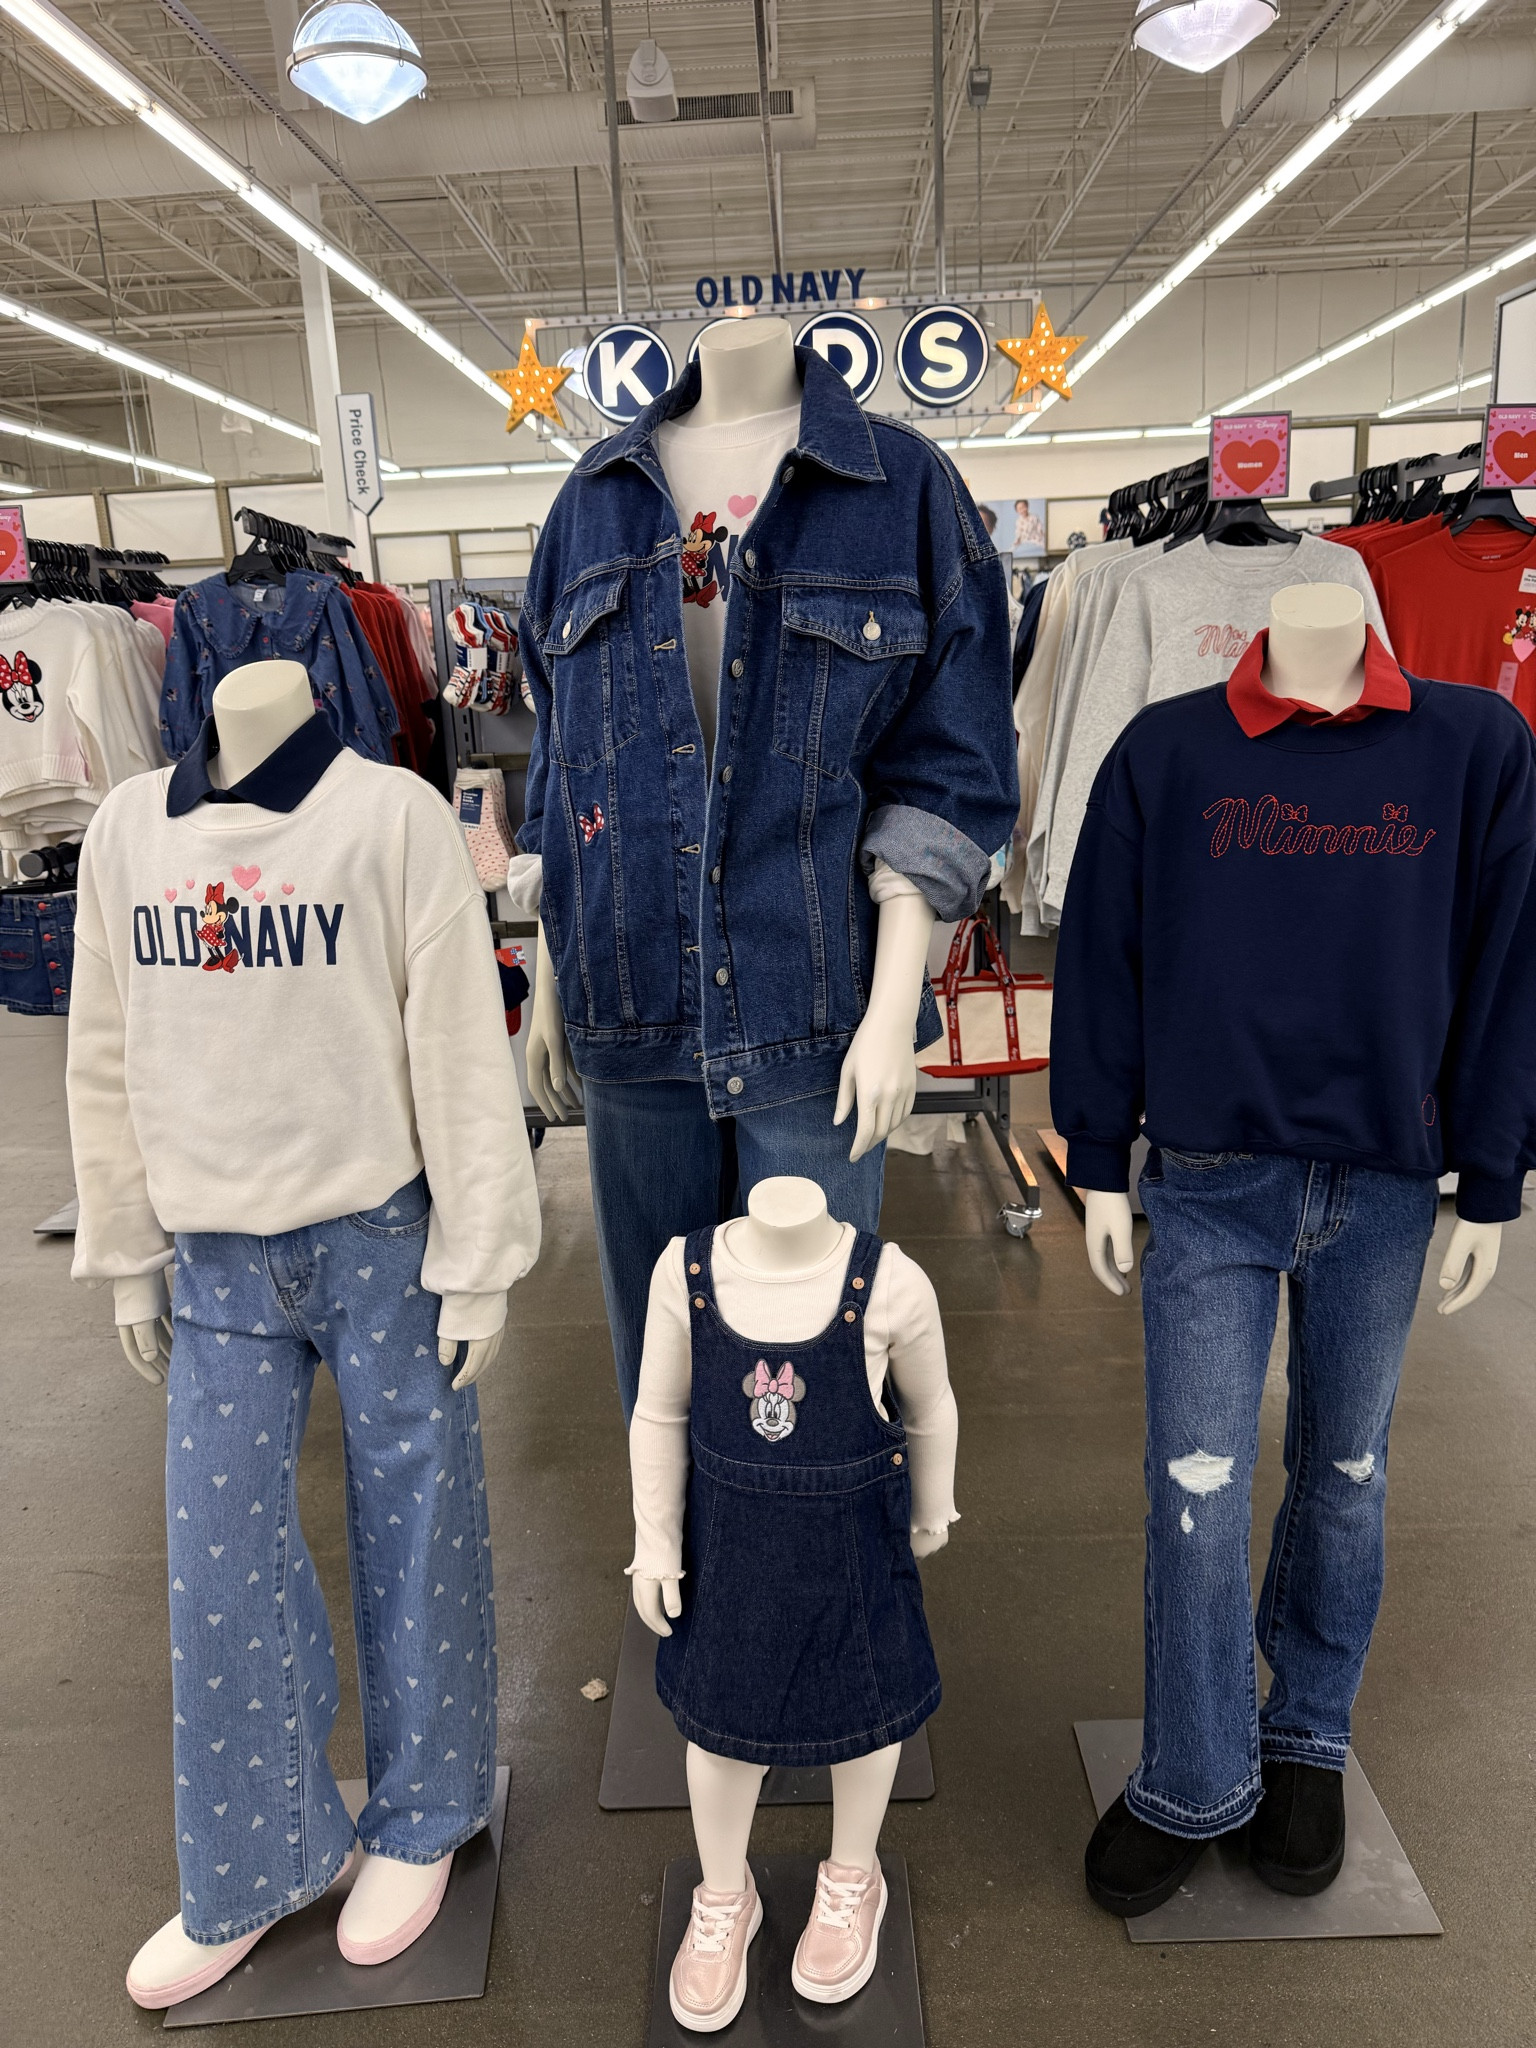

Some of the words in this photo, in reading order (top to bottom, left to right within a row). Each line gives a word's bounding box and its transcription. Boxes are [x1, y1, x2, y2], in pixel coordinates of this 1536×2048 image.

[696, 275, 763, 307] OLD
[771, 268, 865, 304] NAVY
[349, 409, 363, 446] Price
[1254, 420, 1278, 431] Disney
[354, 450, 370, 494] Check
[1203, 794, 1437, 858] Minnie
[133, 905, 202, 967] OLD
[224, 903, 345, 968] NAVY
